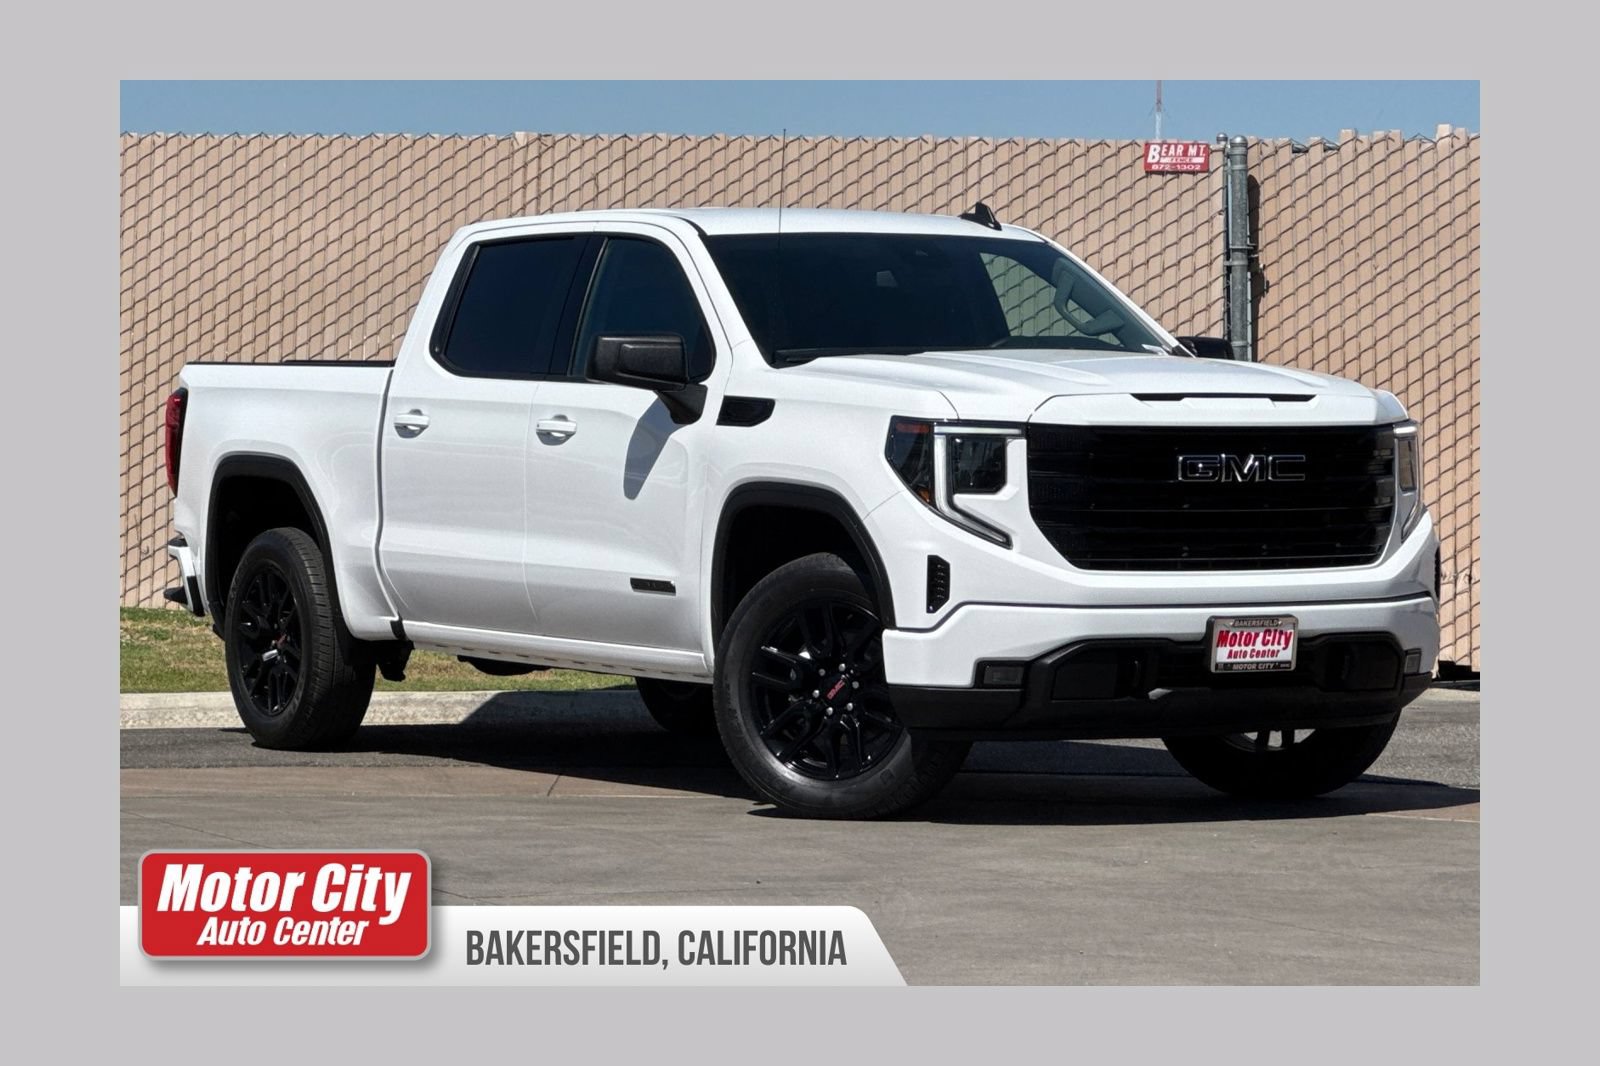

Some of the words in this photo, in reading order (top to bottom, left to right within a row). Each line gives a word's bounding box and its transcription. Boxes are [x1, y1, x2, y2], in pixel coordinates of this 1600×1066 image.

[1147, 144, 1184, 163] BEAR
[1178, 454, 1306, 482] GMC
[1217, 629, 1260, 648] Motor
[1261, 628, 1292, 651] City
[1227, 649, 1248, 659] Auto
[1249, 648, 1280, 659] Center
